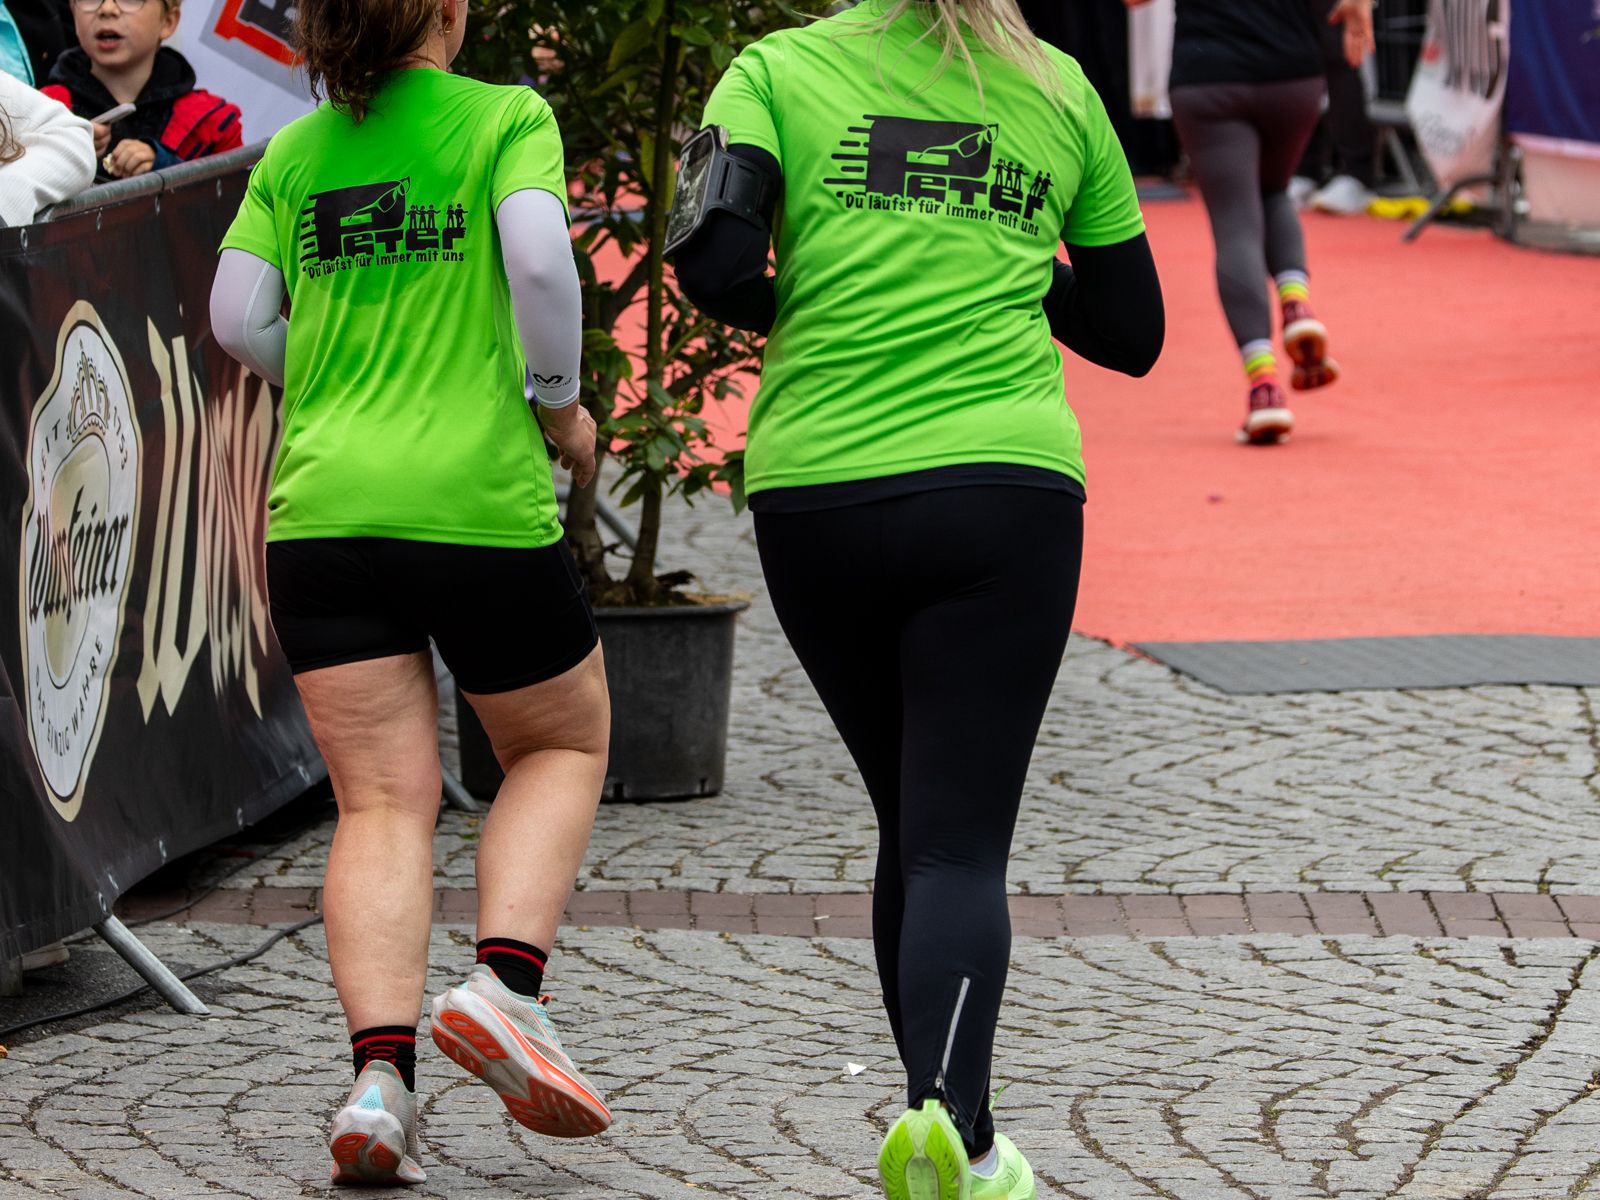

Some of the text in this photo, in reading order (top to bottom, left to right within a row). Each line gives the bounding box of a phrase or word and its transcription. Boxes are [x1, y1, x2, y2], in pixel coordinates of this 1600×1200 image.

[846, 194, 1040, 237] Du läufst für immer mit uns
[307, 250, 465, 280] Du läufst für immer mit uns
[29, 484, 129, 625] Warsteiner
